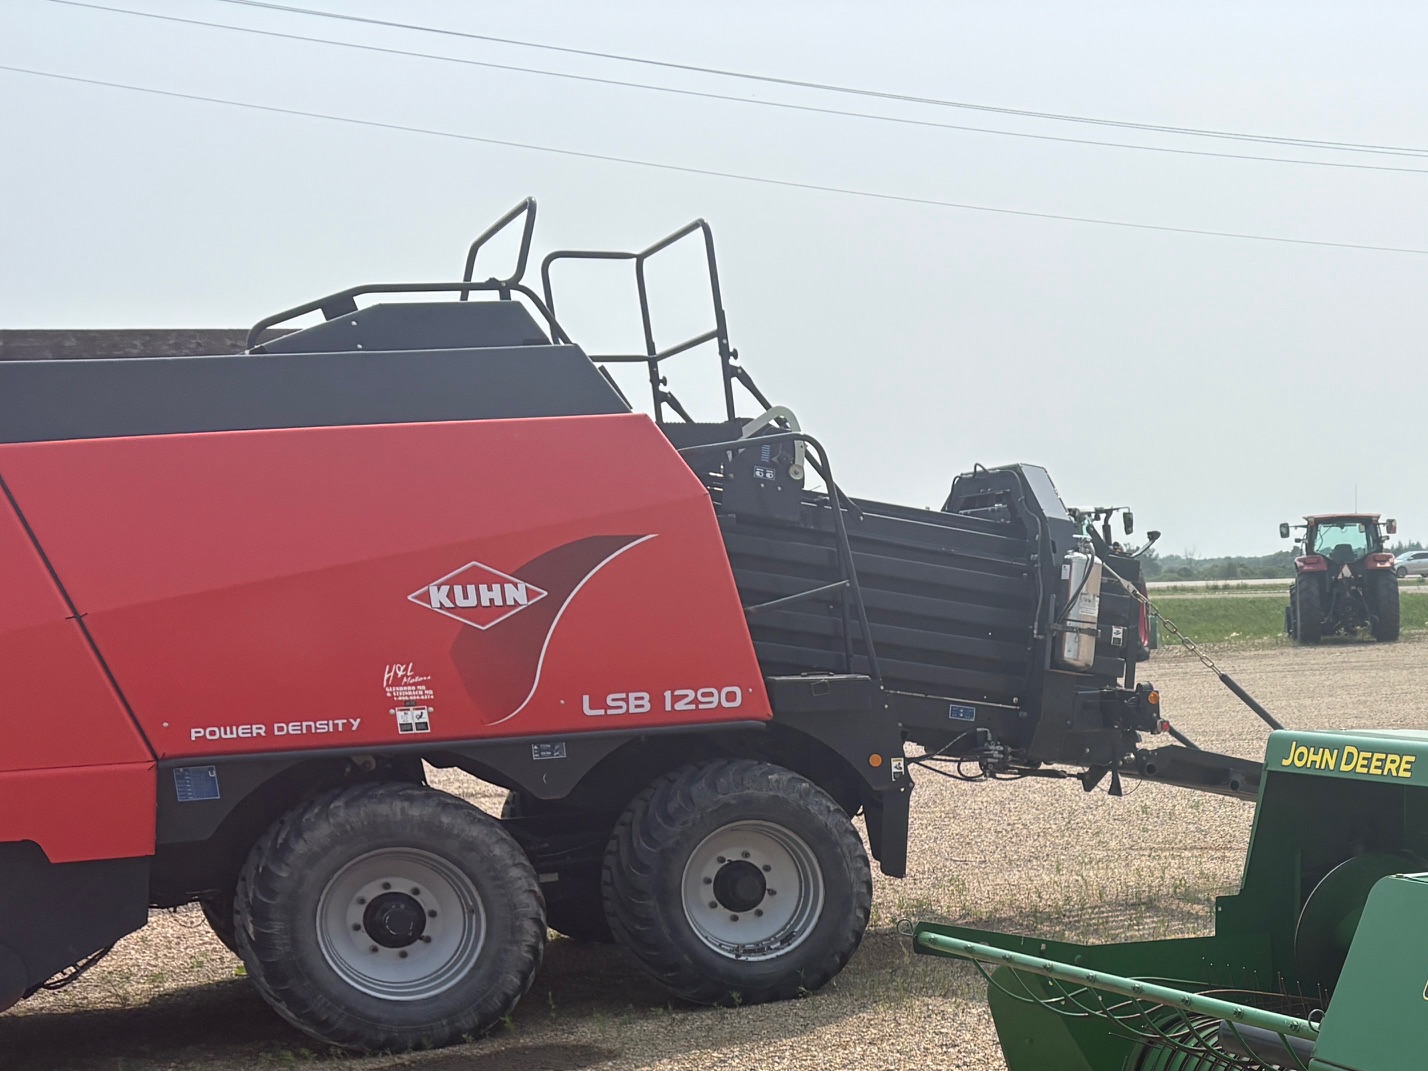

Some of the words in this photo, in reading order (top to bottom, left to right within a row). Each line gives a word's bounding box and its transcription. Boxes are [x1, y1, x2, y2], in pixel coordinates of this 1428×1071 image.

[428, 583, 528, 608] KUHN
[582, 691, 651, 716] LSB
[663, 685, 743, 712] 1290
[190, 723, 267, 741] POWER
[273, 718, 361, 736] DENSITY
[1281, 741, 1339, 771] JOHN
[1339, 745, 1416, 778] DEERE
